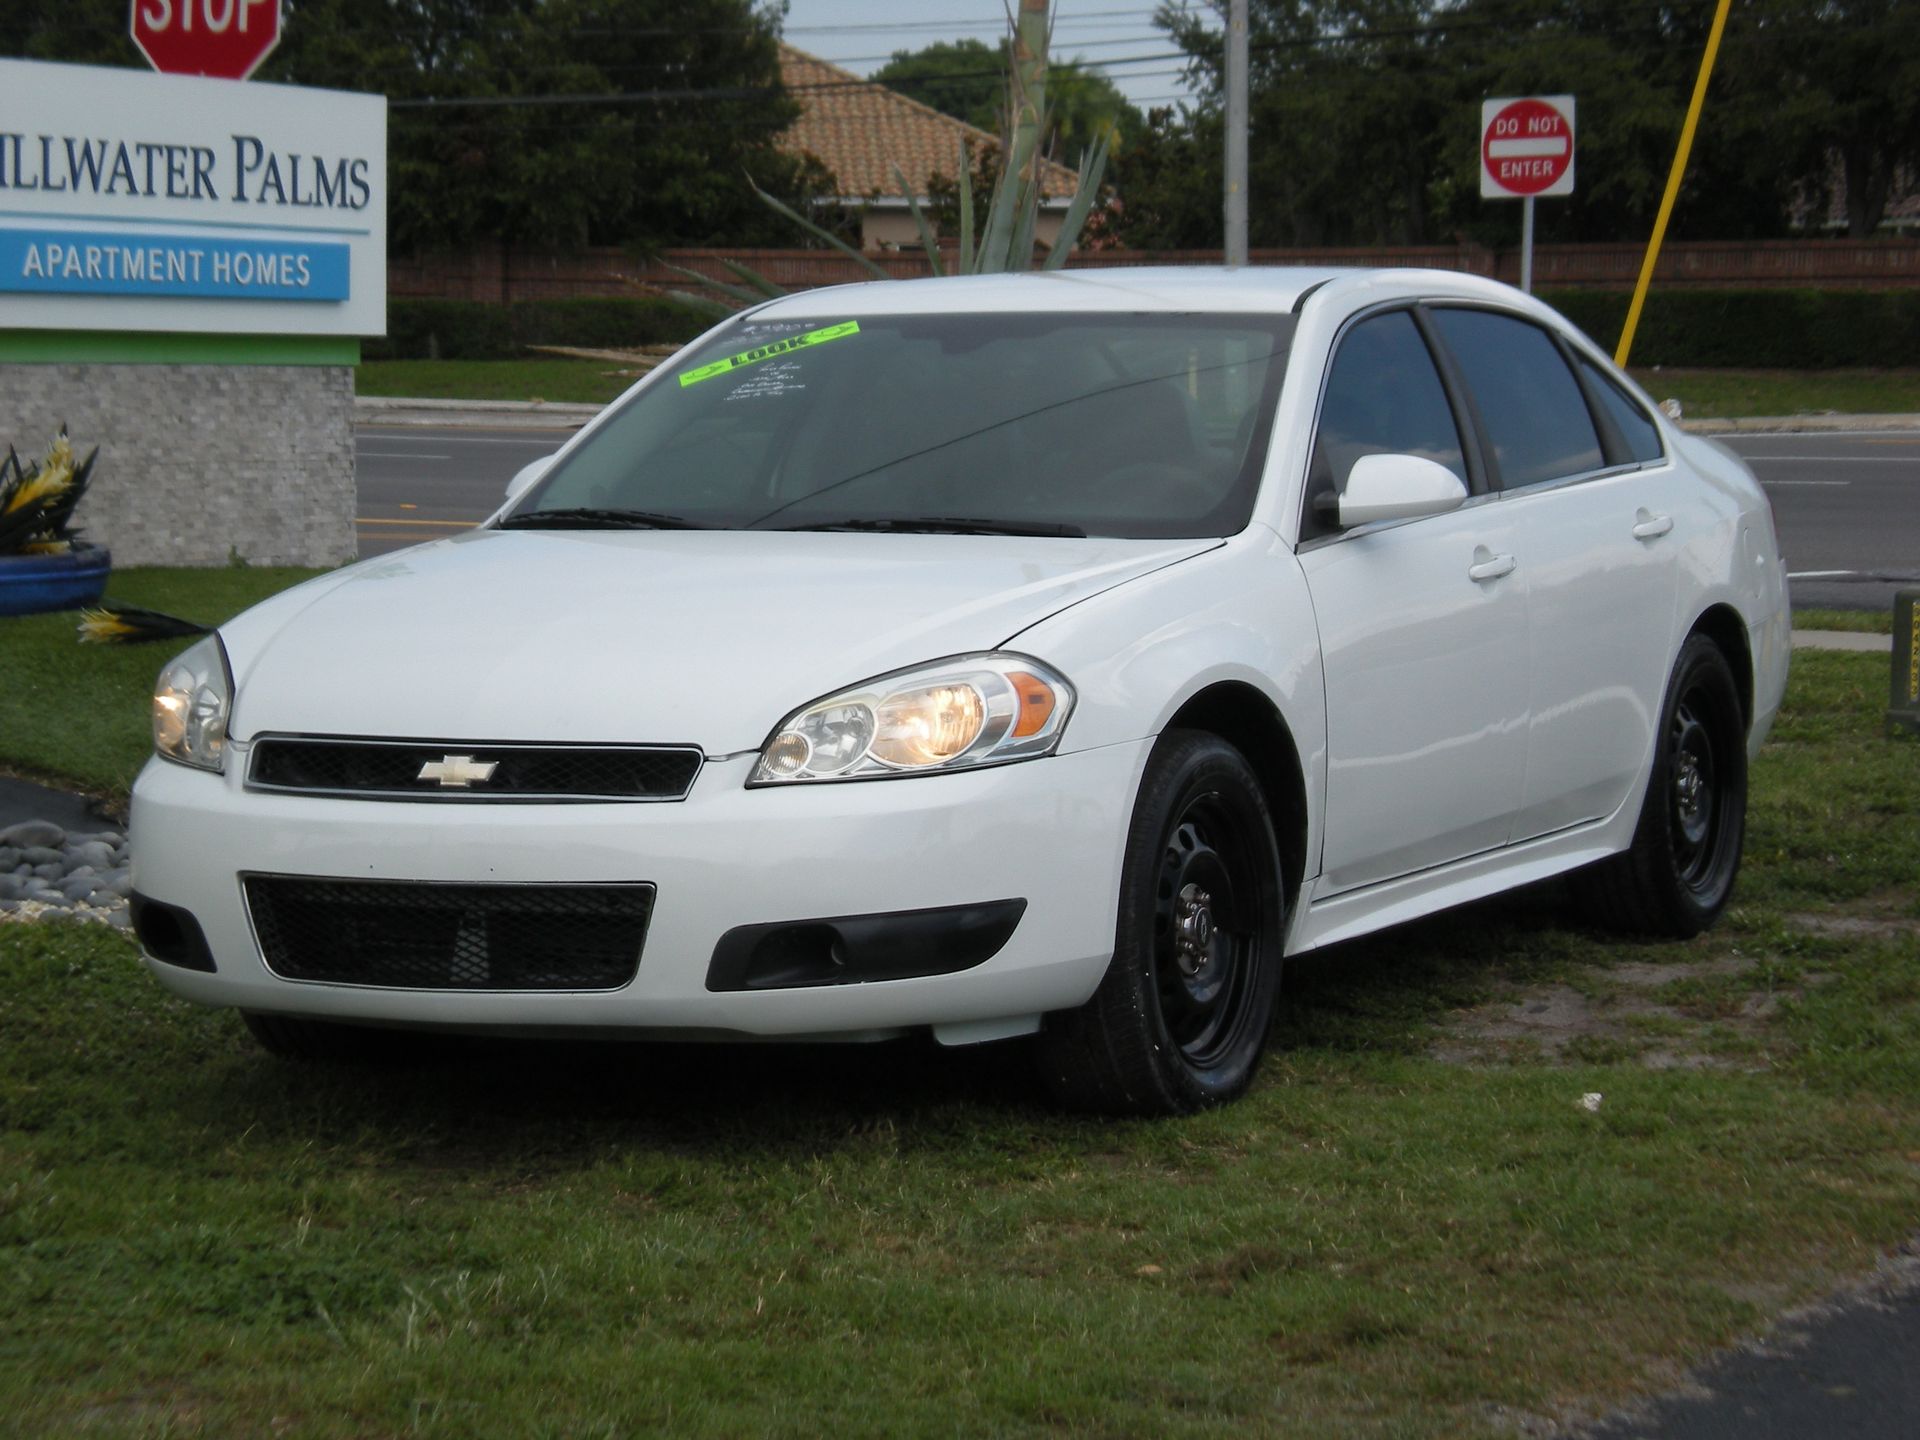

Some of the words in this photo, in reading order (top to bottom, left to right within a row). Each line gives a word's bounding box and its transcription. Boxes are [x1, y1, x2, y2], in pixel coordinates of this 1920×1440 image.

[1496, 118, 1519, 135] DO
[1528, 115, 1560, 133] NOT
[1501, 161, 1553, 177] ENTER
[22, 243, 205, 284] APARTMENT
[213, 250, 311, 287] HOMES
[730, 335, 810, 366] LOOK
